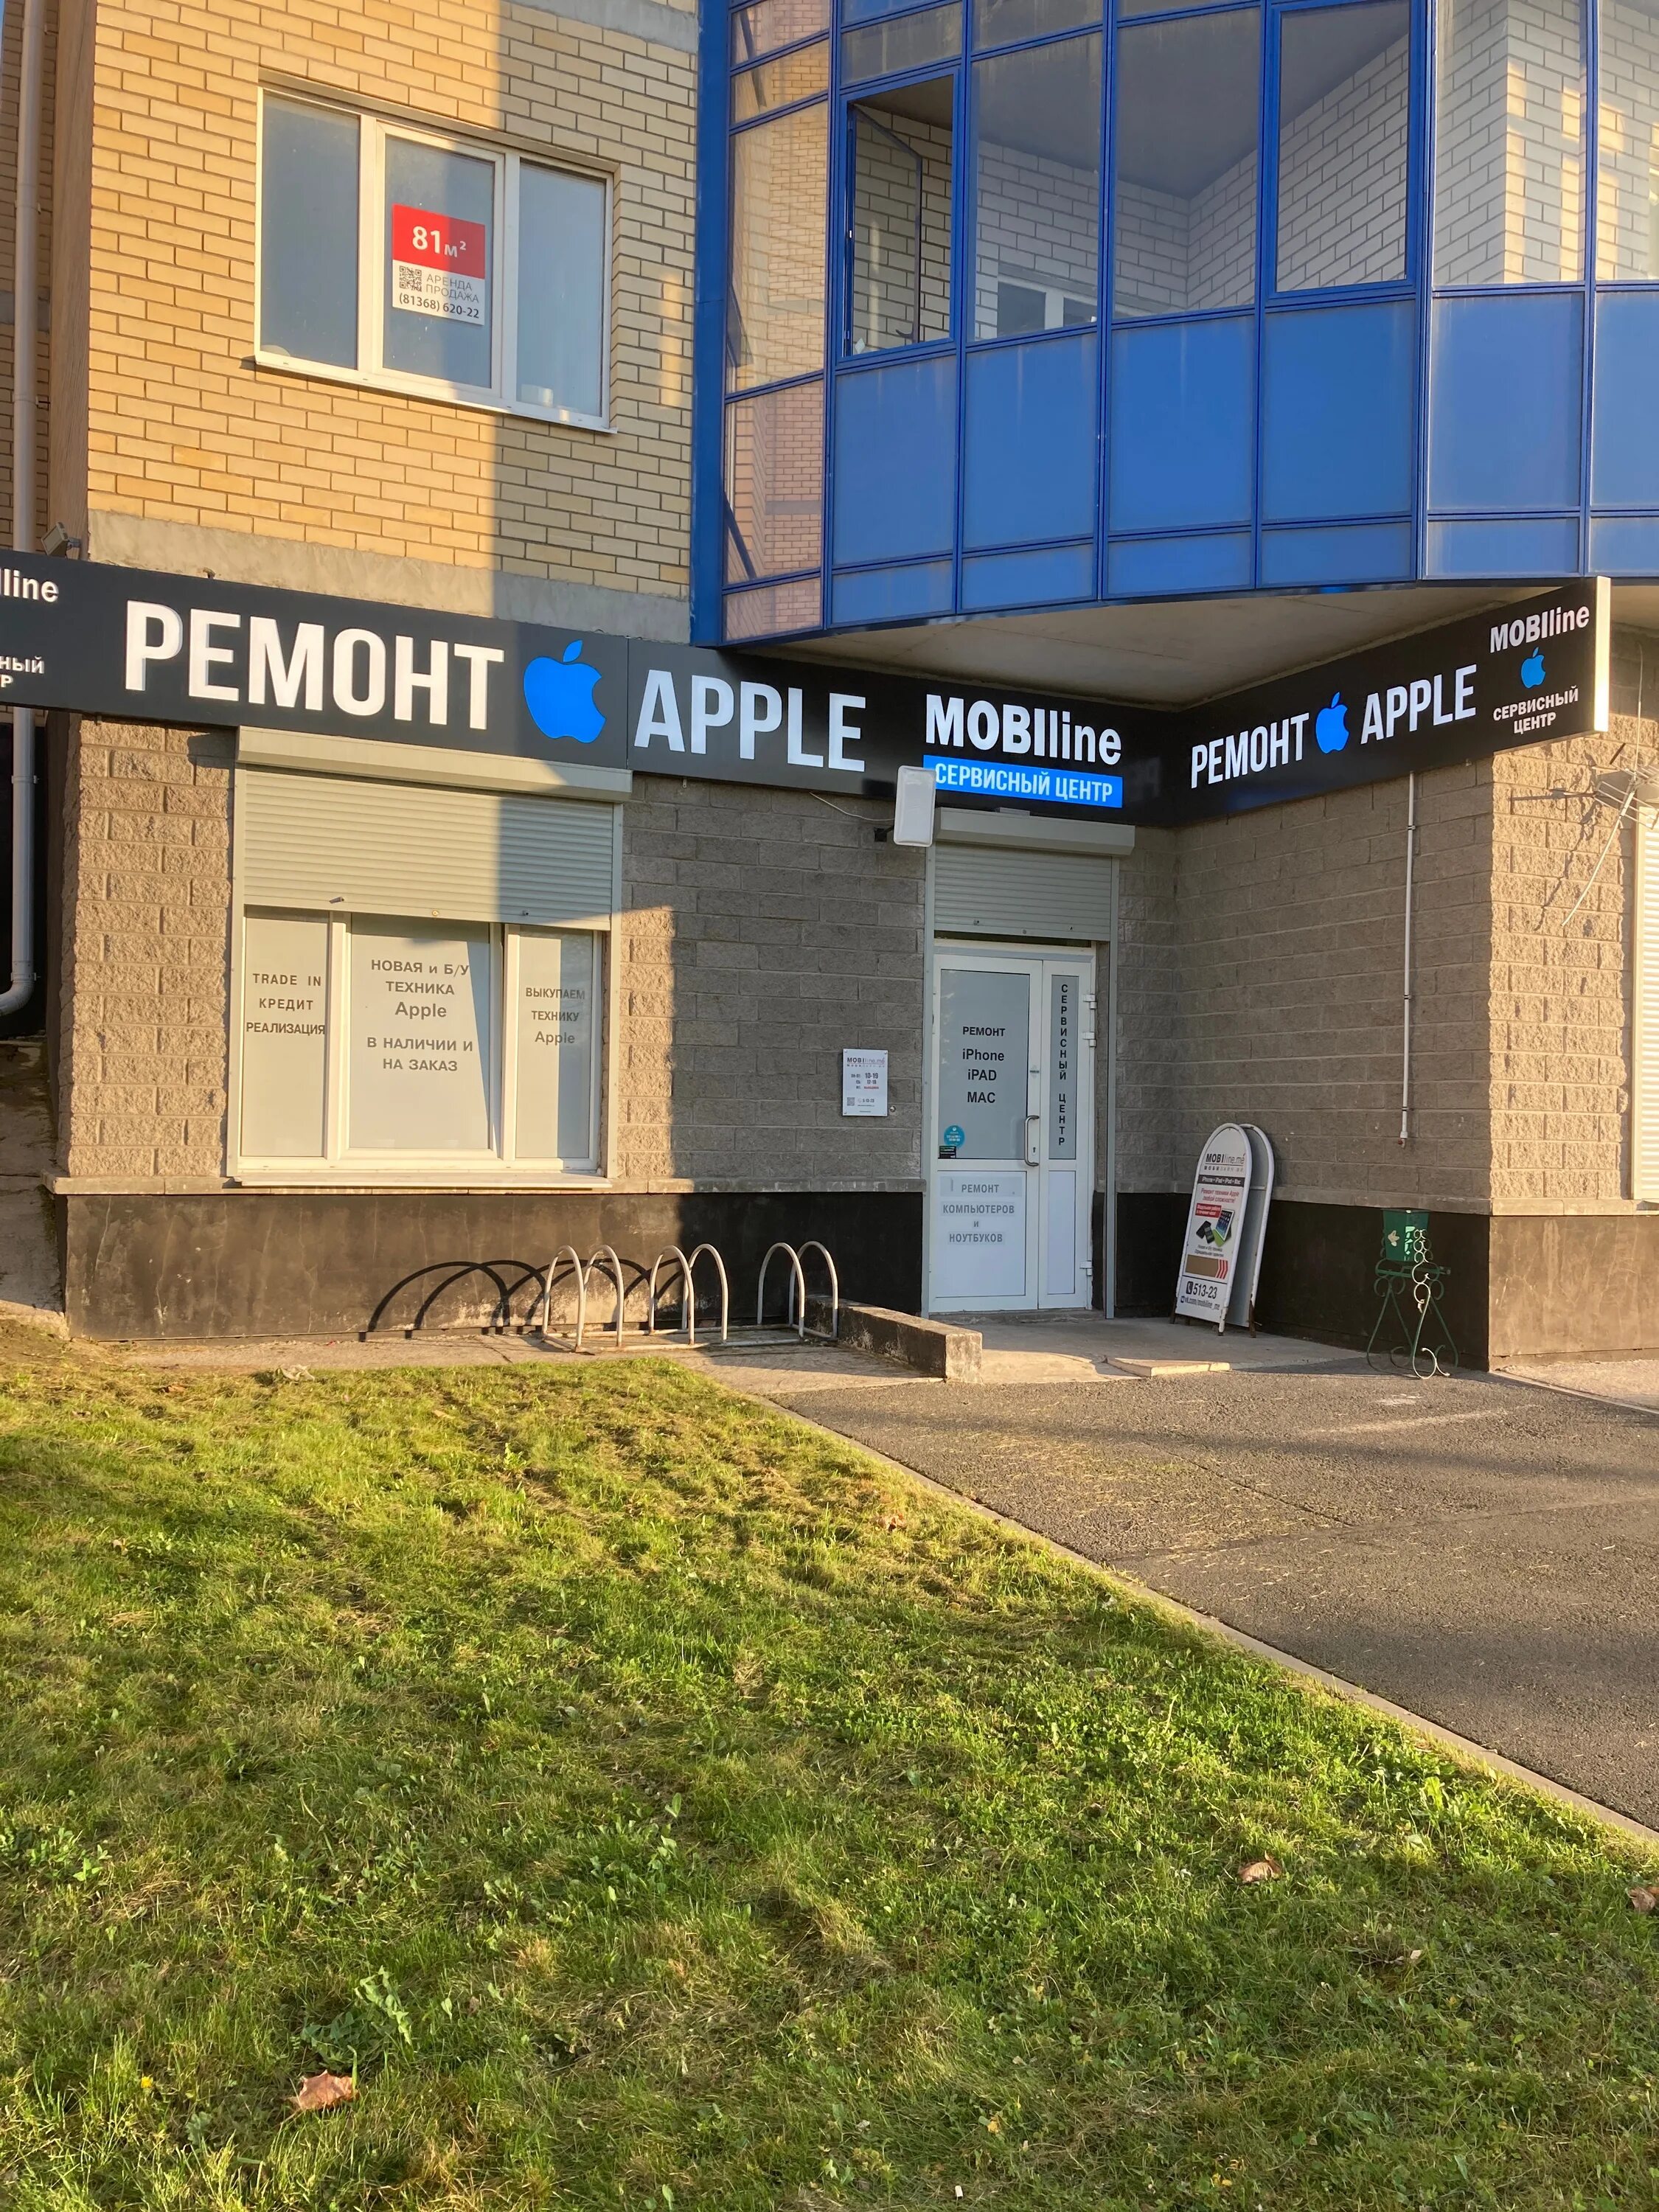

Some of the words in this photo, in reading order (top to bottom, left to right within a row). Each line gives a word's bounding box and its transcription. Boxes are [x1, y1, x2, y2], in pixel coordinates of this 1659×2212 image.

[426, 274, 472, 291] АРЕНДА
[425, 285, 479, 303] ПРОДАЖА
[399, 293, 440, 312] (81368)
[442, 302, 479, 319] 620-22
[0, 568, 59, 602] line
[1489, 605, 1590, 653] MOBIline
[125, 599, 505, 730] РЕМОНТ
[633, 669, 866, 773] APPLE
[1493, 684, 1579, 722] СЕРВИСНЫЙ
[925, 694, 1121, 765] MOBIline
[1191, 712, 1310, 789] РЕМОНТ
[1360, 664, 1477, 745] APPLE
[1514, 712, 1556, 734] ЦЕНТР
[935, 762, 1050, 796] СЕРВИСНЫЙ
[1055, 778, 1113, 802] ЦЕНТР
[371, 959, 423, 973] НОВАЯ
[443, 963, 470, 978] Б/У
[253, 973, 298, 986] TRADE
[307, 975, 321, 987] IN
[385, 981, 455, 995] ТЕХНИКА
[525, 987, 585, 1001] ВЫКУПАЕМ
[259, 998, 314, 1011] КРЕДИТ
[394, 1001, 448, 1020] Apple
[531, 1009, 580, 1023] ТЕХНИКУ
[246, 1021, 325, 1037] РЕАЛИЗАЦИЯ
[962, 1026, 1006, 1037] РЕМОНТ
[1058, 984, 1068, 1081] СЕРВИСНЫЙ
[367, 1037, 378, 1048] В
[383, 1037, 457, 1051] НАЛИЧИИ
[463, 1040, 473, 1052] И
[535, 1031, 575, 1046] Apple
[962, 1048, 1005, 1062] iPhone
[383, 1058, 403, 1070] НА
[408, 1059, 459, 1072] ЗАКАЗ
[967, 1068, 997, 1081] iPAD
[967, 1091, 996, 1104] MAC
[1058, 1093, 1066, 1146] ЦЕНТР
[961, 1183, 1000, 1194] РЕМОНТ
[942, 1203, 1015, 1215] КОМПЬЮТЕРОВ
[949, 1231, 1004, 1243] НОУТБУКОВ
[1192, 1283, 1218, 1299] 513-23
